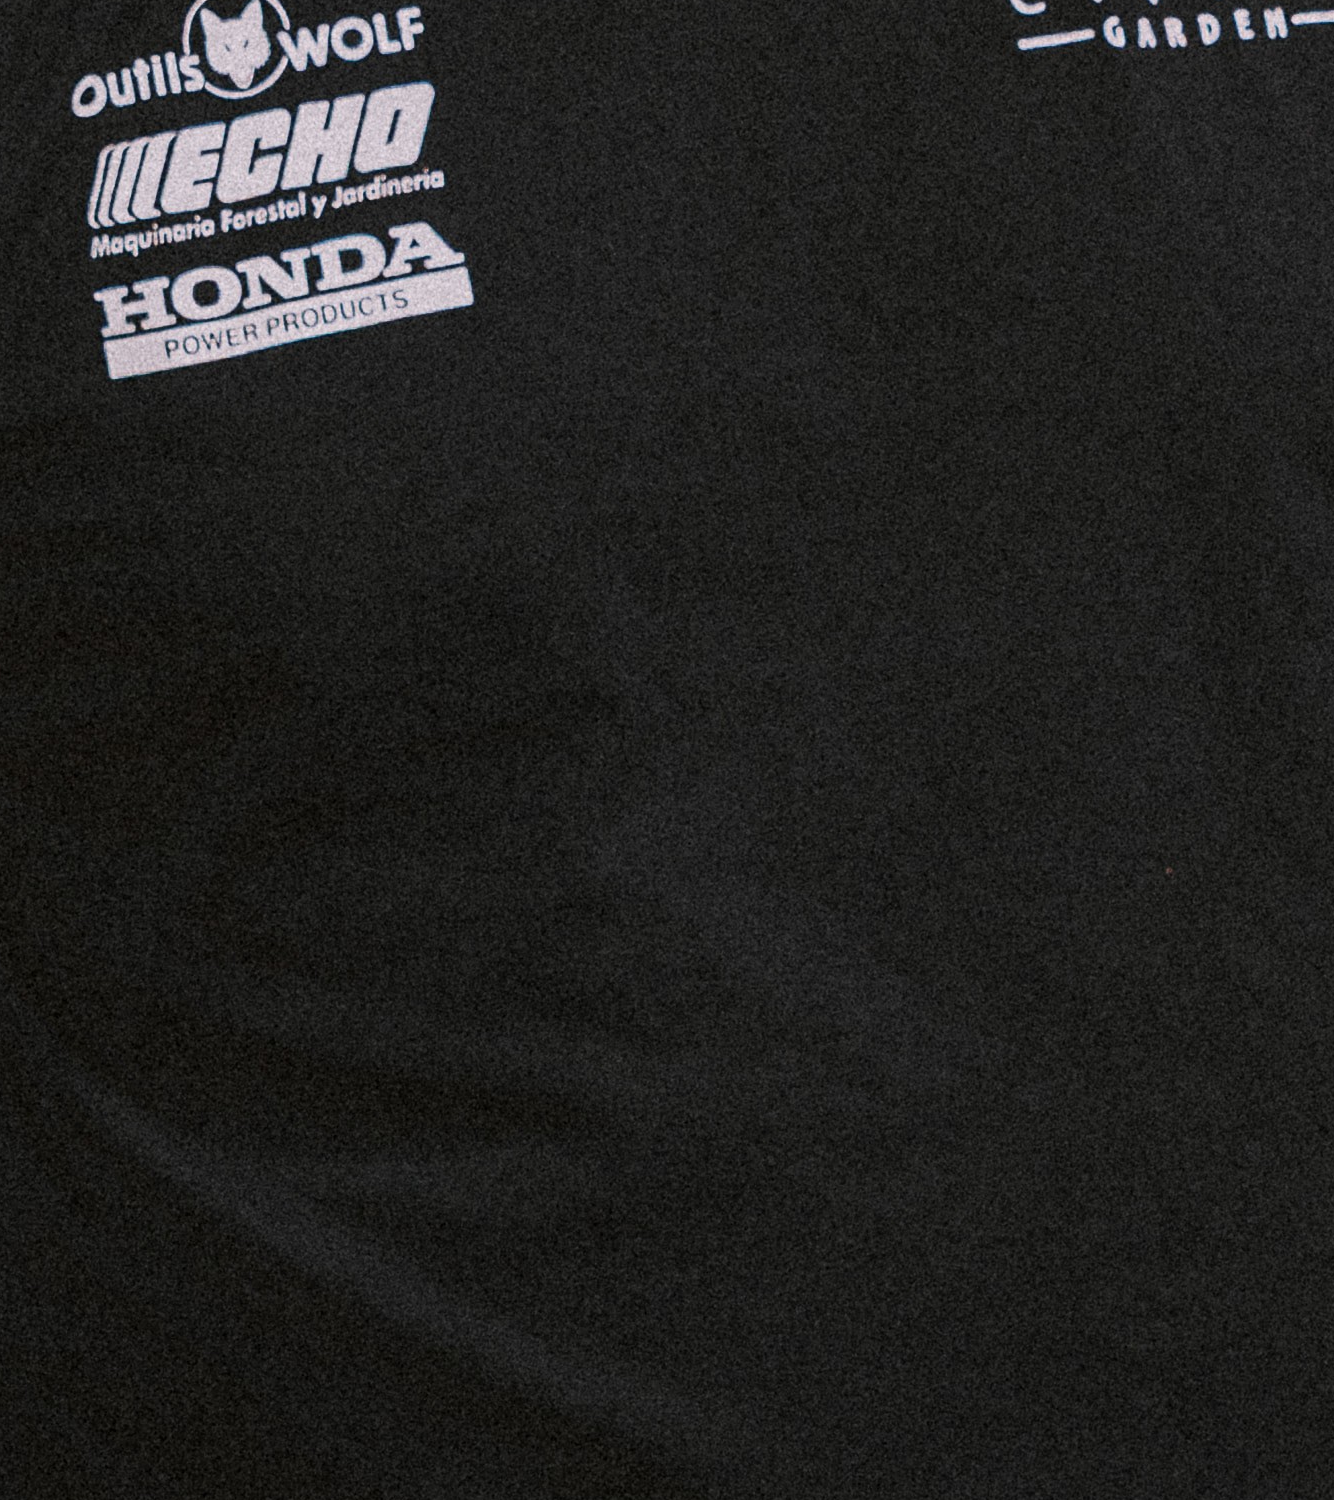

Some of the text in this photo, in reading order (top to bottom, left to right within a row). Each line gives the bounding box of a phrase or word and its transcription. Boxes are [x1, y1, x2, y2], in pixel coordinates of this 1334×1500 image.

[72, 6, 424, 118] Outils WOLF
[1103, 6, 1289, 49] GARDEN
[161, 81, 436, 215] ECHO
[90, 214, 216, 259] Maquinaria
[220, 191, 307, 233] Forestal
[311, 194, 328, 219] y
[93, 221, 465, 338] HONDA
[165, 288, 410, 359] POWER PRODUCTS
